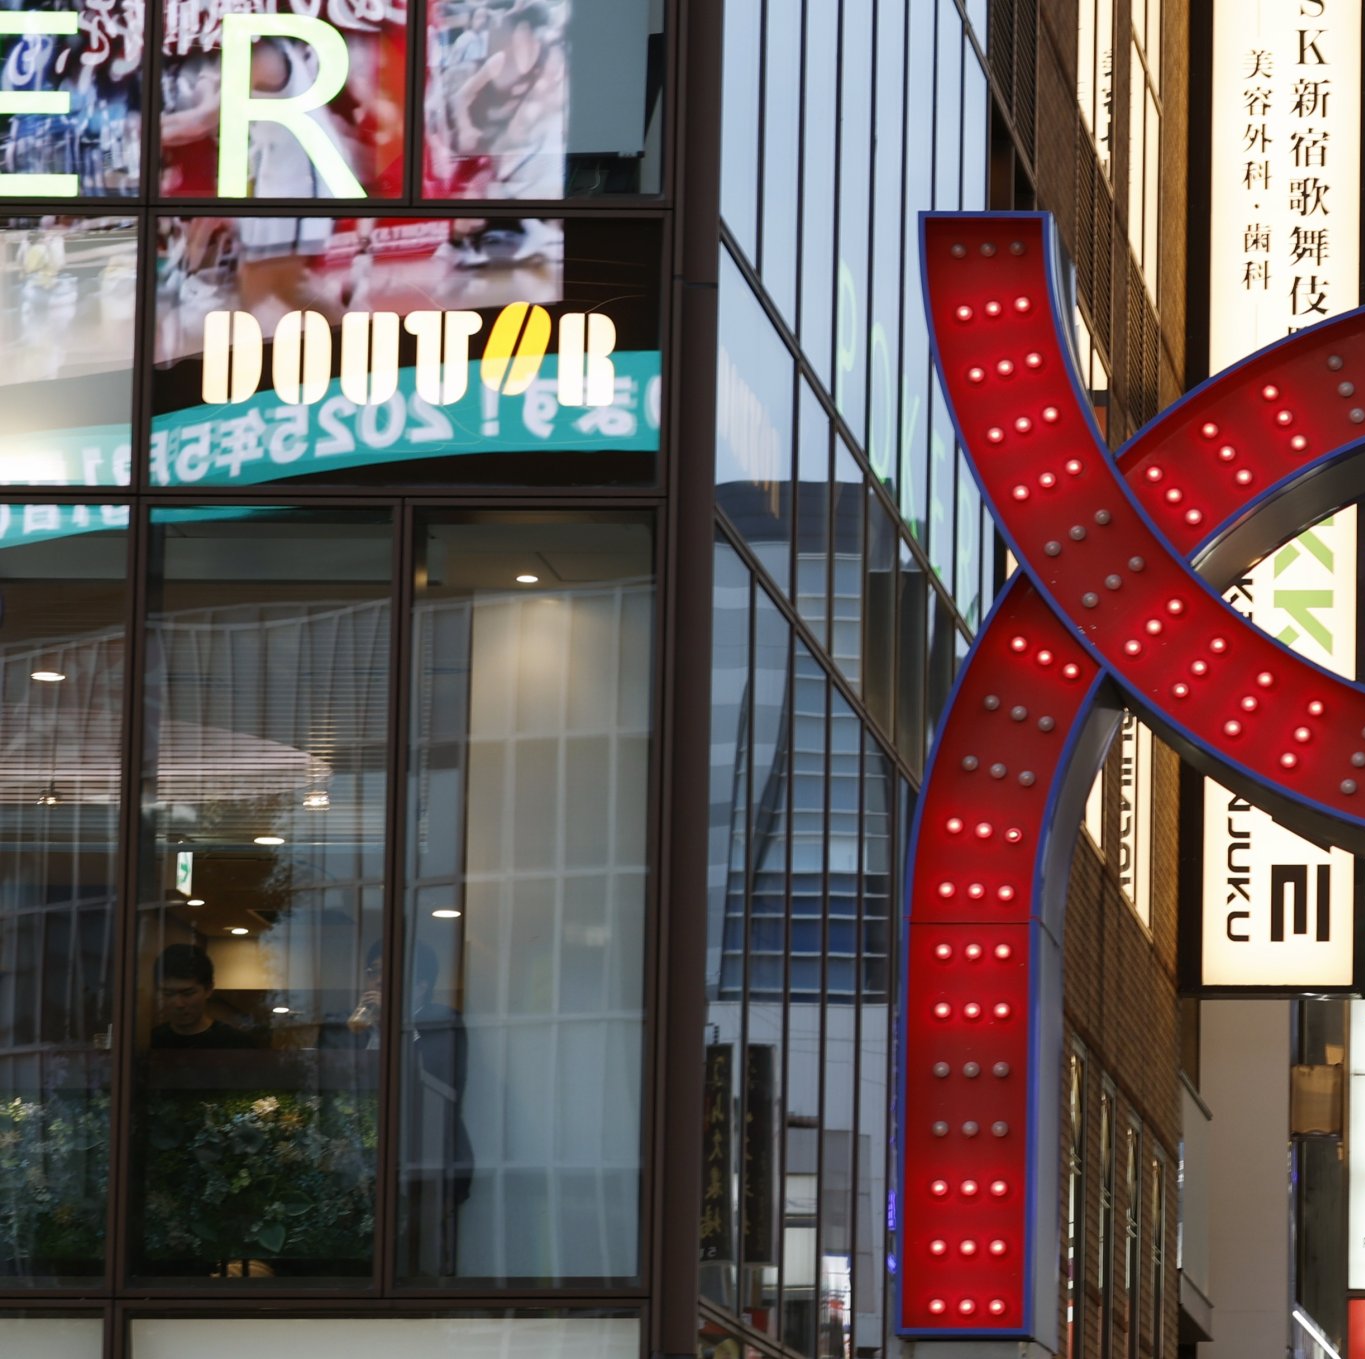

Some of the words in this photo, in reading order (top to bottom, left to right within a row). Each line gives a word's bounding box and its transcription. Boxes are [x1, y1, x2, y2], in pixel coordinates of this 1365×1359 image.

[1241, 49, 1274, 291] 美容外科・歯科
[201, 301, 617, 407] DOUTOR
